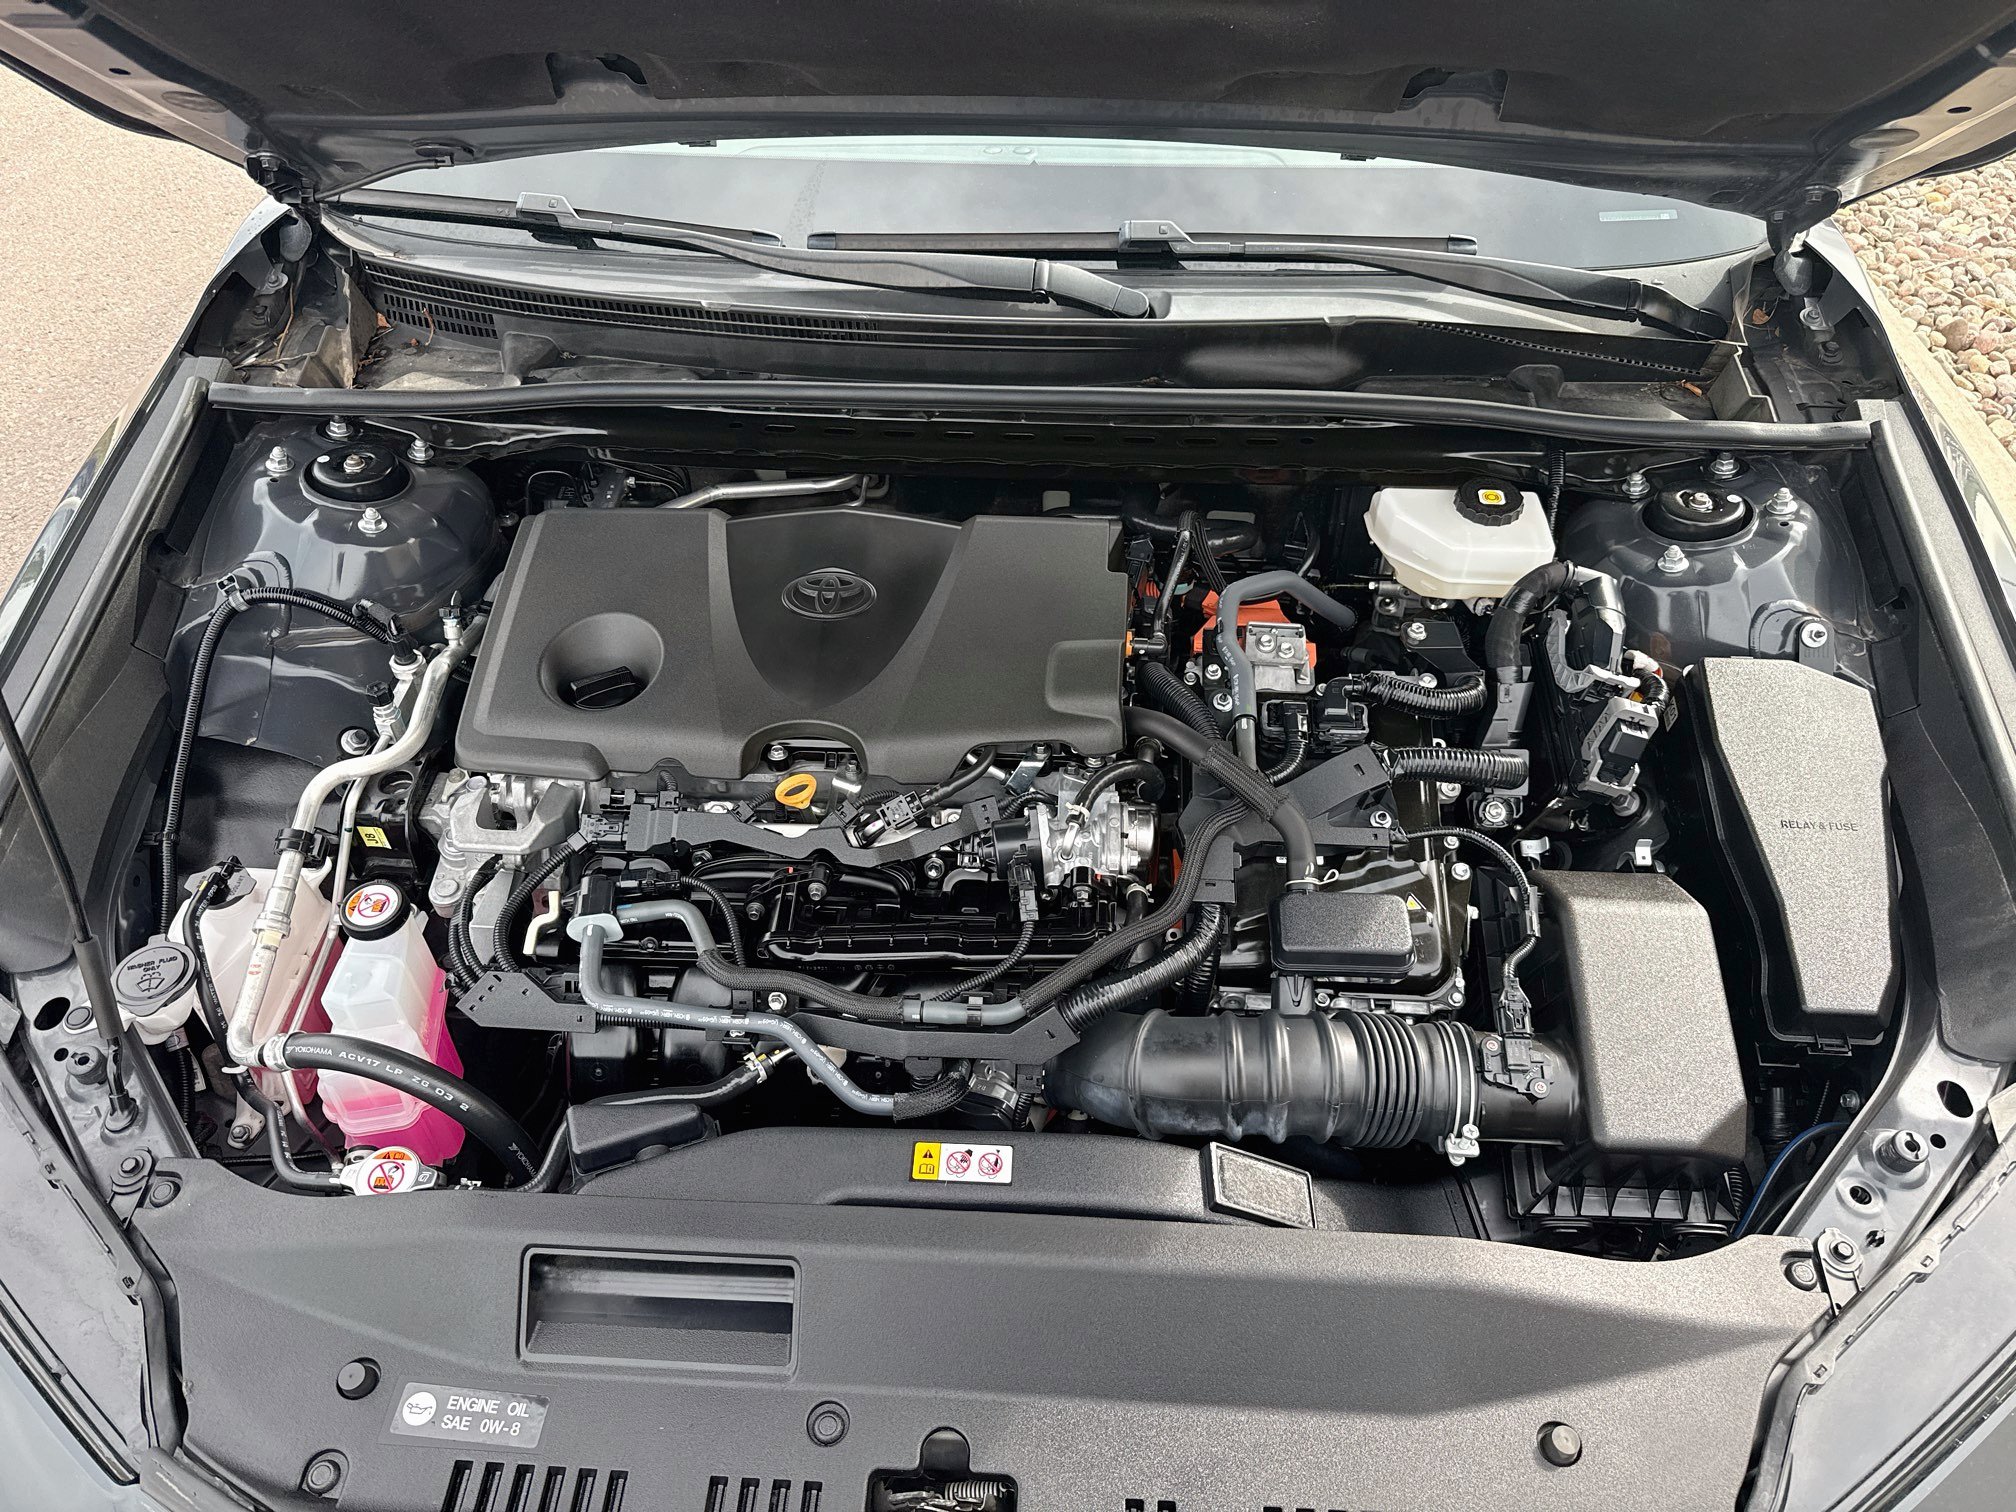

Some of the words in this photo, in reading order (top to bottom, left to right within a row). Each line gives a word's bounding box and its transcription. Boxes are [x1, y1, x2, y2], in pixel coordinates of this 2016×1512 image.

[1780, 819, 1816, 829] RELAY
[1819, 821, 1826, 829] &
[1829, 821, 1858, 831] FUSE
[143, 965, 161, 973] ONLY
[159, 955, 178, 964] FLUID
[209, 983, 218, 1004] WATER
[294, 1045, 333, 1056] YOKOHAMA
[339, 1051, 380, 1067] ACV17
[385, 1064, 403, 1075] LP
[459, 1102, 470, 1112] 2
[447, 1395, 500, 1414] ENGINE
[507, 1402, 529, 1417] OIL
[441, 1414, 472, 1431] SAE
[480, 1419, 521, 1436] 0W-8
